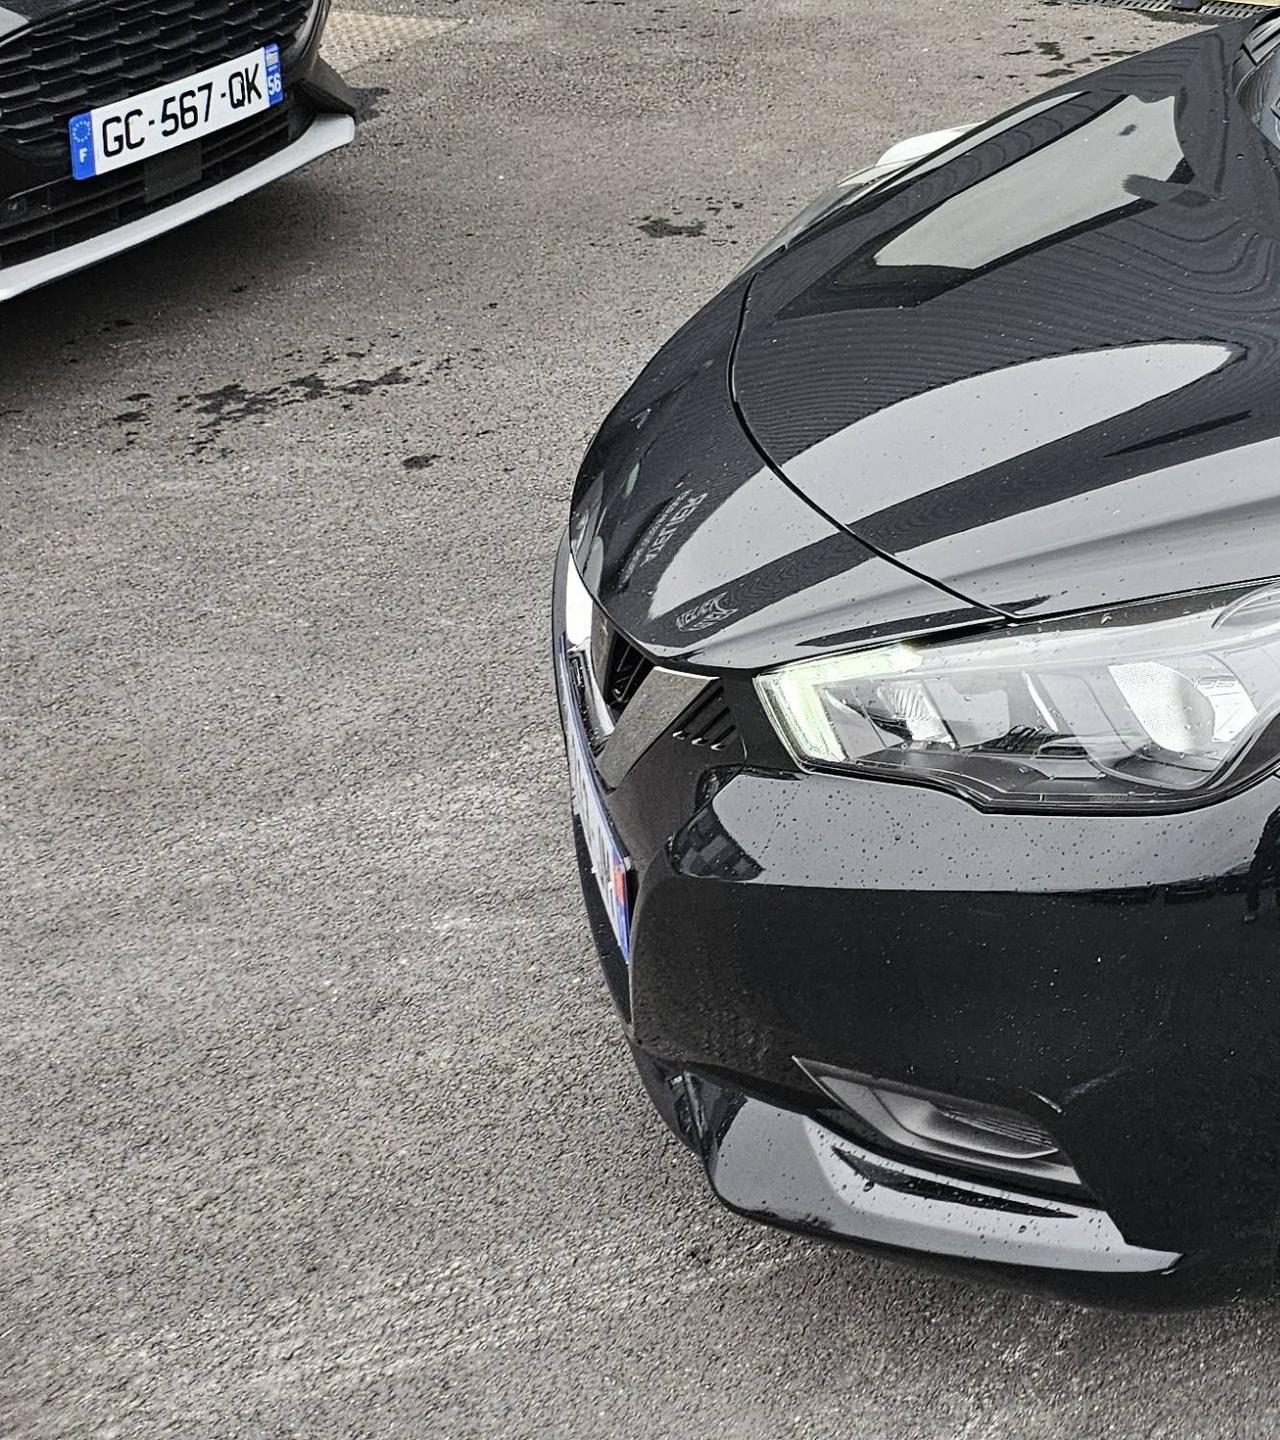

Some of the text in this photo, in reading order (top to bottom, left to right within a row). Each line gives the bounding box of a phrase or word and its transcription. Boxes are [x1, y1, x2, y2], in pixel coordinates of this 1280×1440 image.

[267, 72, 282, 96] 56
[101, 62, 263, 158] GC-567-QK
[78, 147, 89, 164] F
